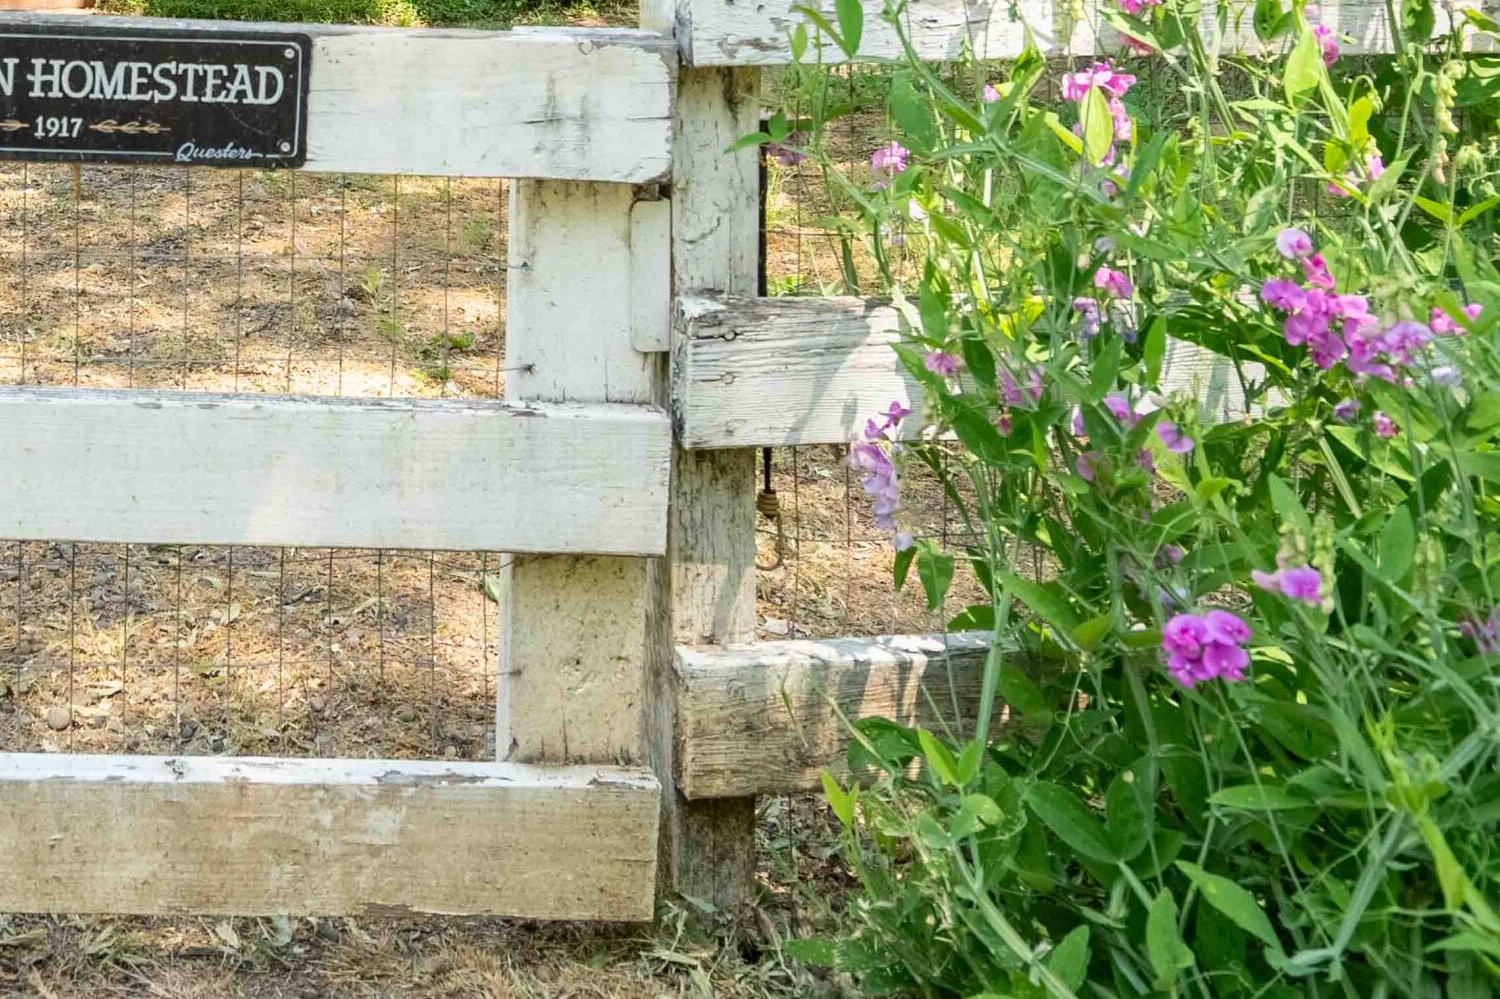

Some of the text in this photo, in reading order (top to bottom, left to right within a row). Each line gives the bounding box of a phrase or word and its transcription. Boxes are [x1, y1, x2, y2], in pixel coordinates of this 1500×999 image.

[26, 58, 284, 105] HOMESTEAD
[35, 116, 83, 139] 1917
[174, 142, 262, 163] Questers
